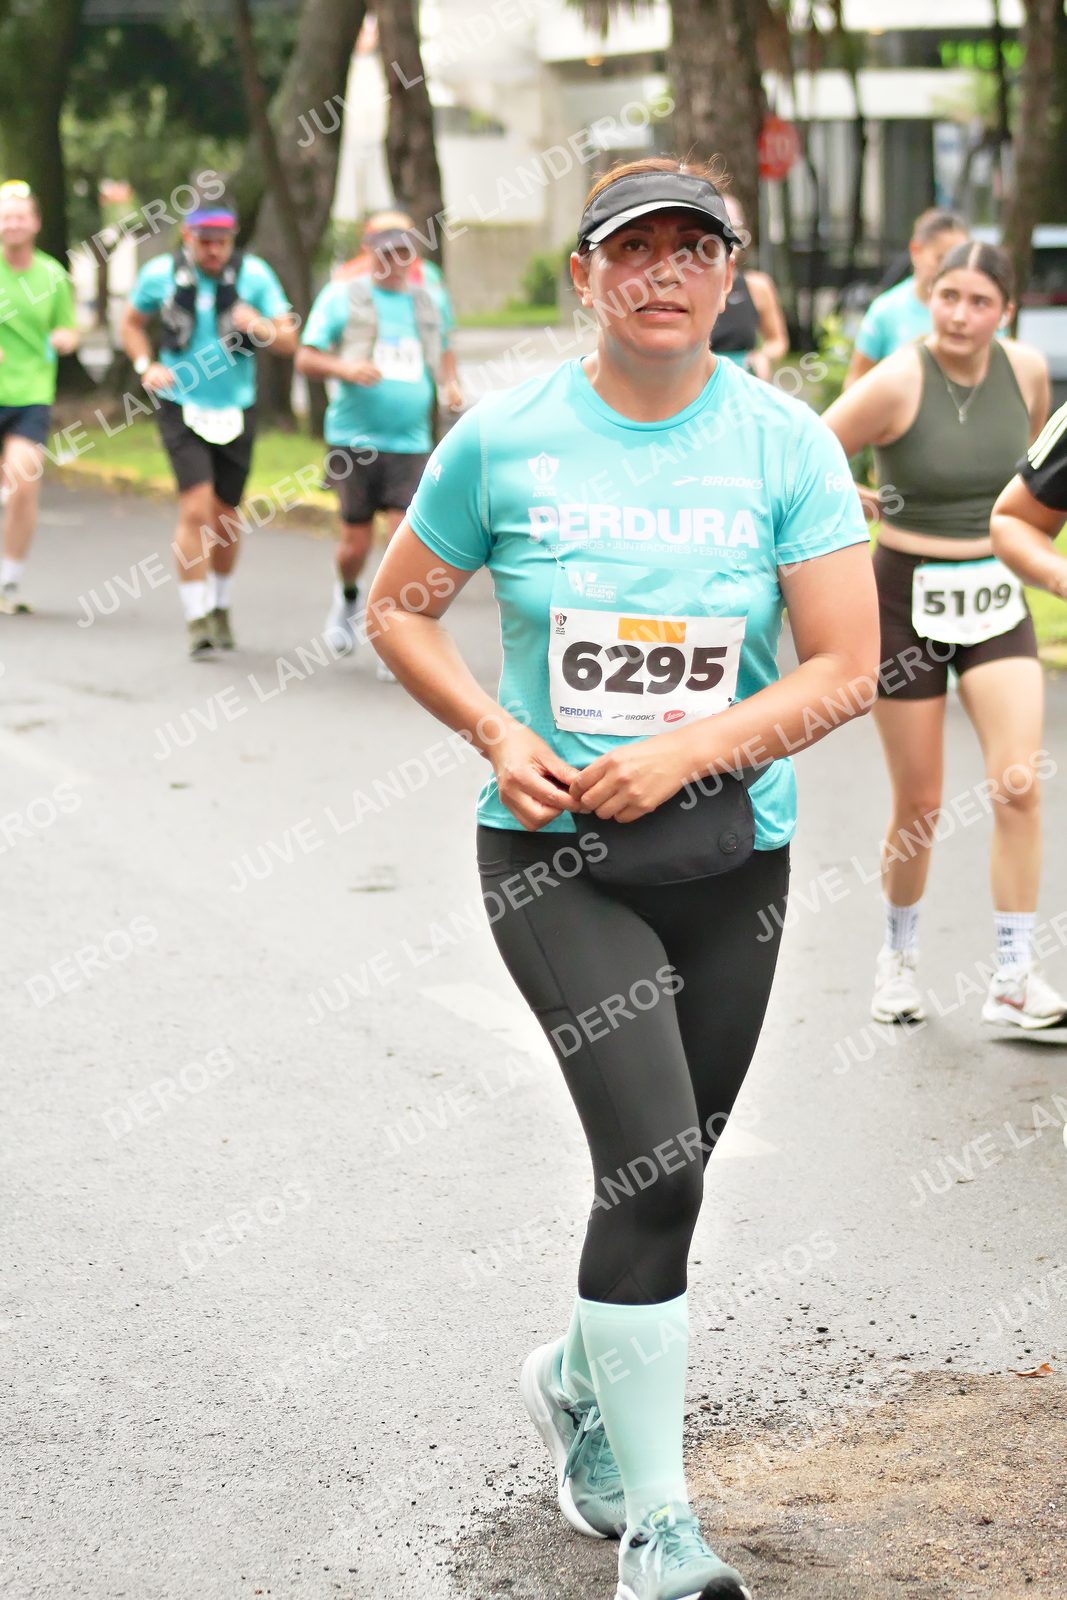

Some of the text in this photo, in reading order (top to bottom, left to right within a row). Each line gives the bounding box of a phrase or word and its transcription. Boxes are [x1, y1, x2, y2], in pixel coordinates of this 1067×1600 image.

[701, 476, 763, 489] BROOKS
[527, 503, 759, 548] PERDURA
[923, 584, 1011, 617] 5109
[562, 641, 728, 695] 6295
[559, 705, 602, 718] PERDURA
